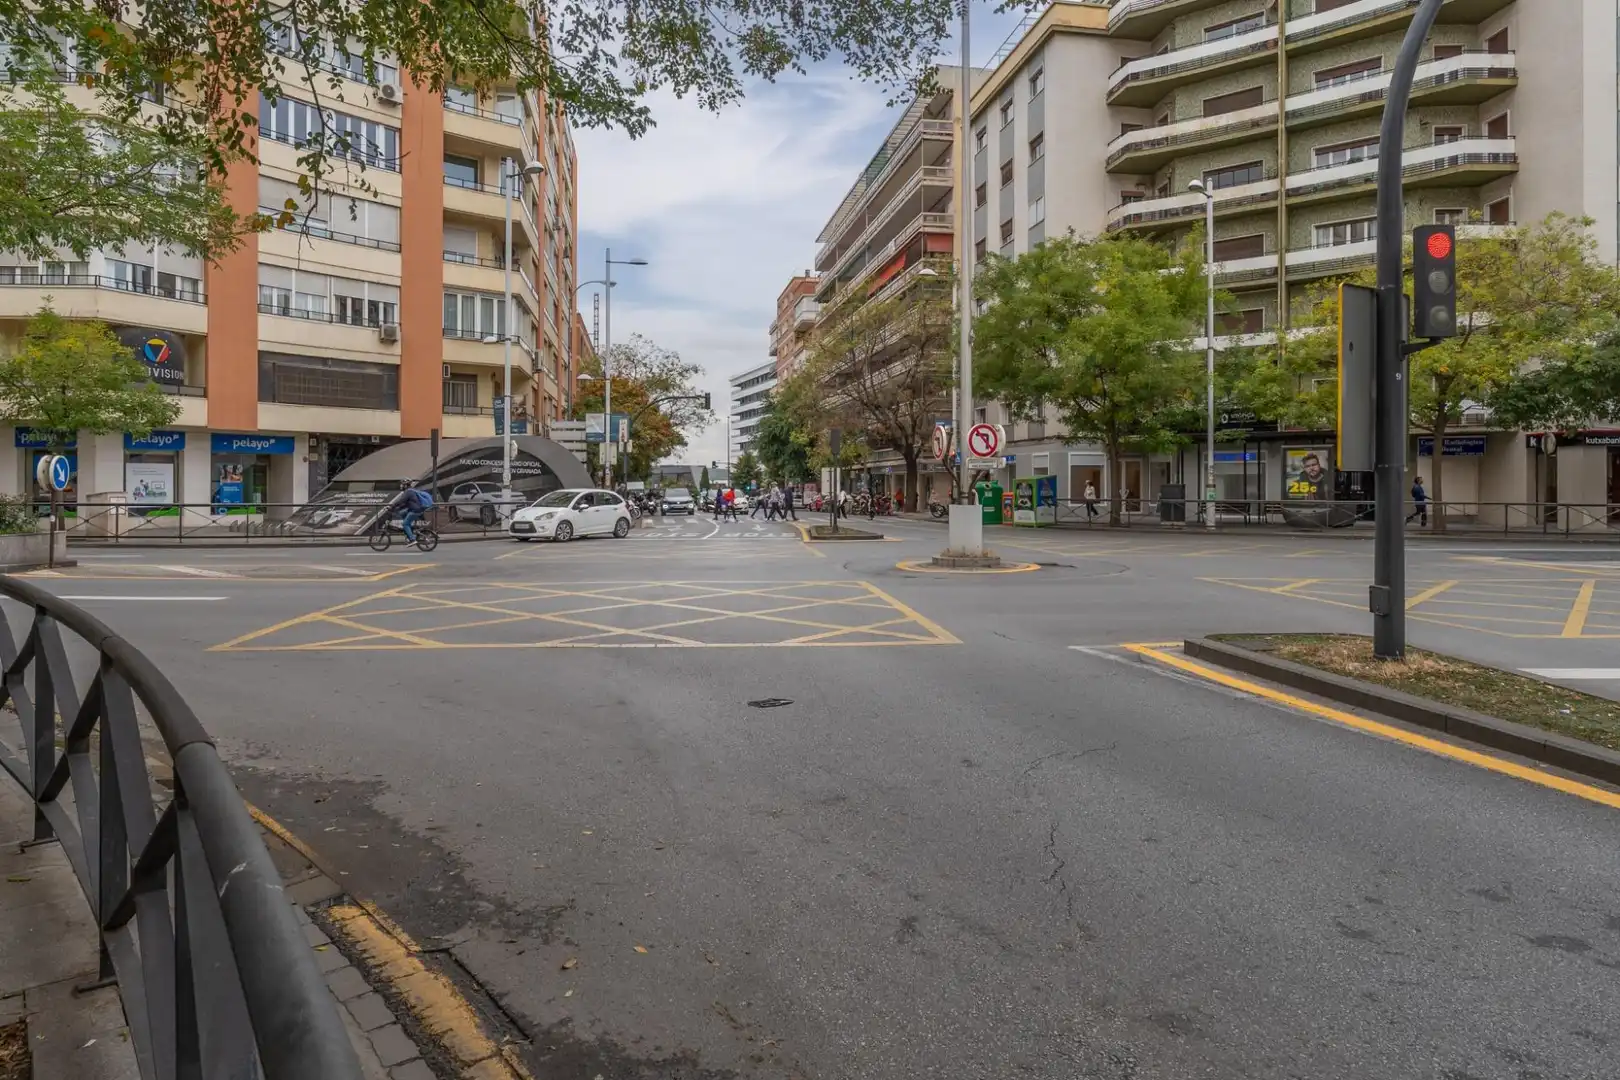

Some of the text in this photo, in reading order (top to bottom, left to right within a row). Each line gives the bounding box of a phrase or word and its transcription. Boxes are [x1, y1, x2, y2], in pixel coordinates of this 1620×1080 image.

[233, 438, 269, 450] pelayo
[1530, 436, 1537, 446] k
[480, 459, 522, 467] CONCESARIO
